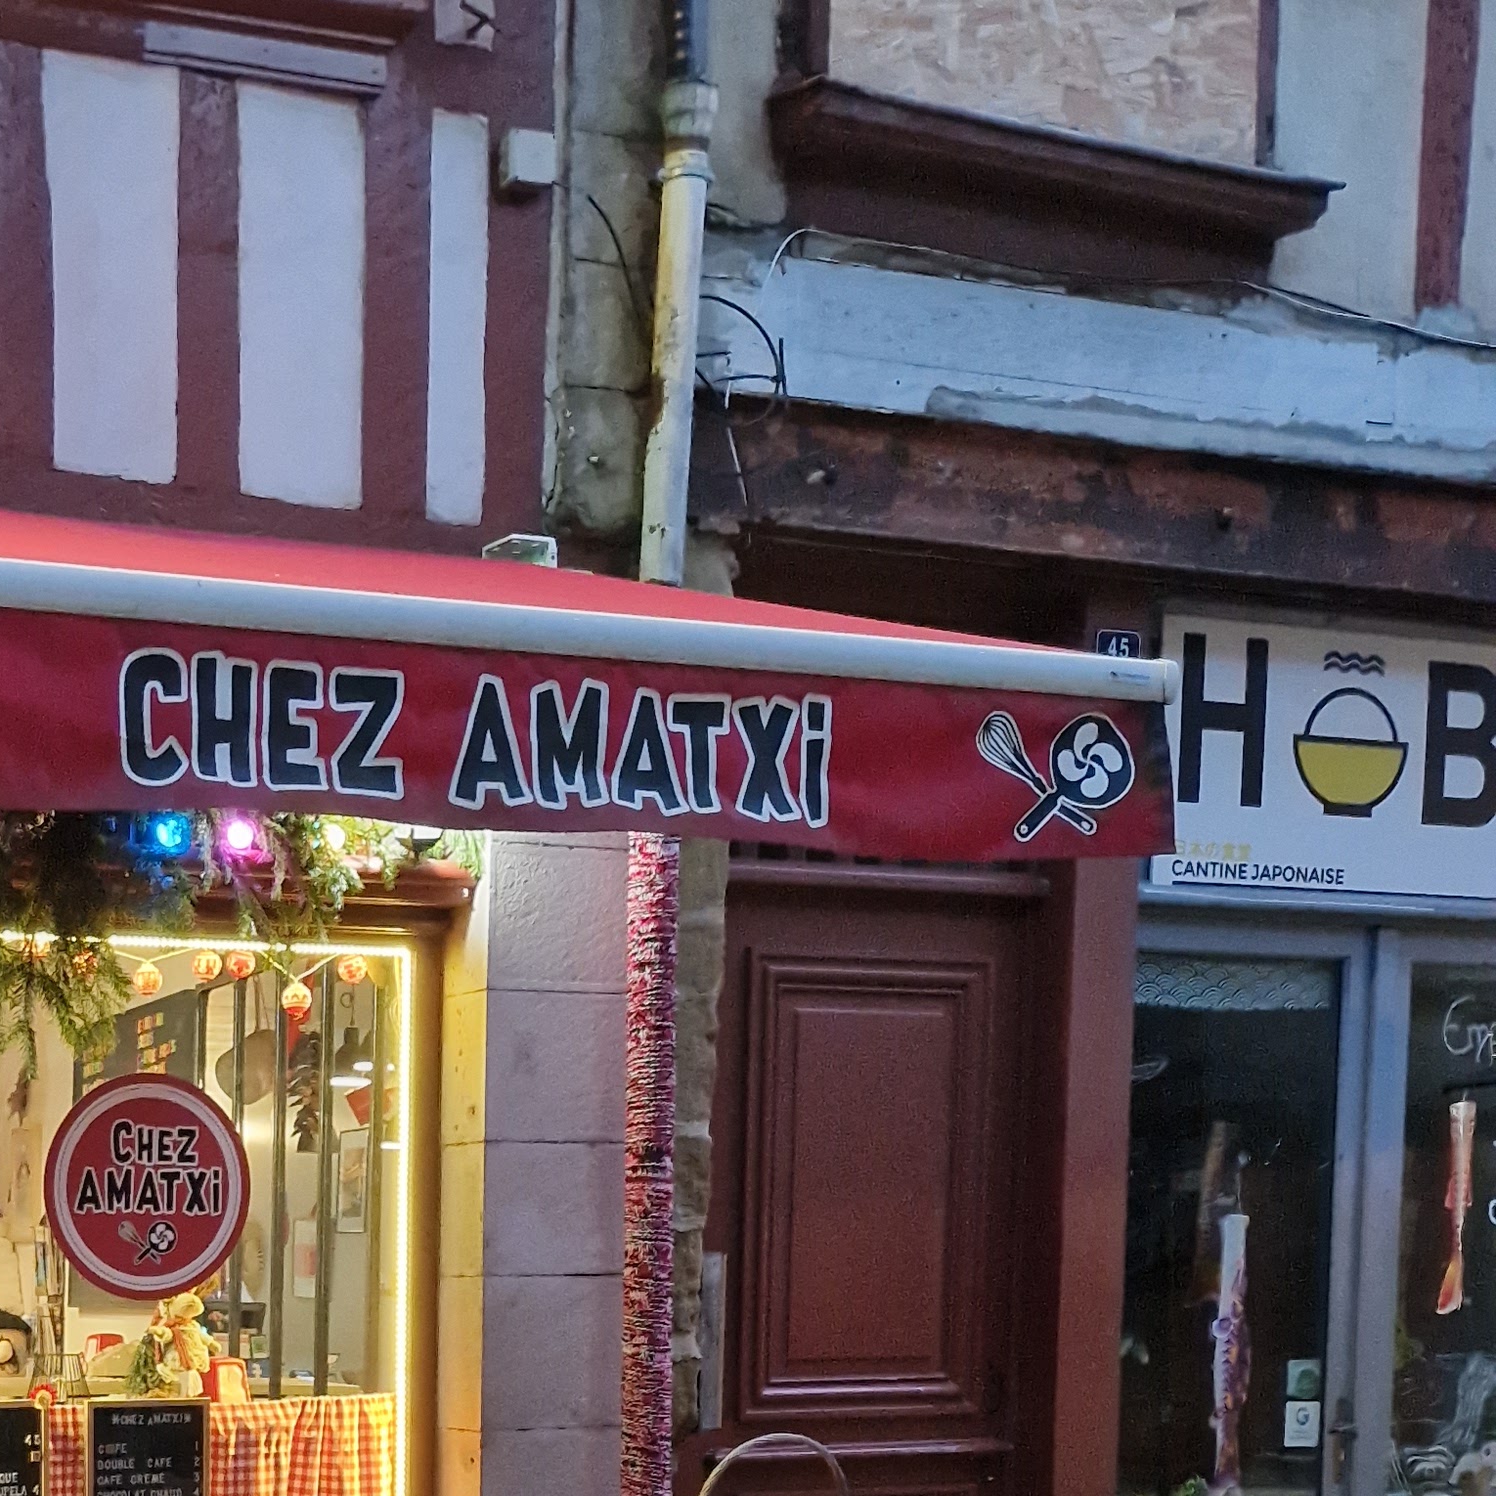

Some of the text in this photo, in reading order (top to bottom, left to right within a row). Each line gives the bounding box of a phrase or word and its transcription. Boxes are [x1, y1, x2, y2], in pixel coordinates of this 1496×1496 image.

[1107, 635, 1130, 658] 45
[119, 647, 405, 800] CHEZ
[1172, 860, 1345, 885] CANTINE JAPONAISE
[98, 1442, 128, 1454] CFE
[97, 1458, 136, 1470] DOUBLE
[147, 1457, 173, 1468] CAFE
[97, 1475, 123, 1486] CAFE
[130, 1473, 165, 1485] CREME
